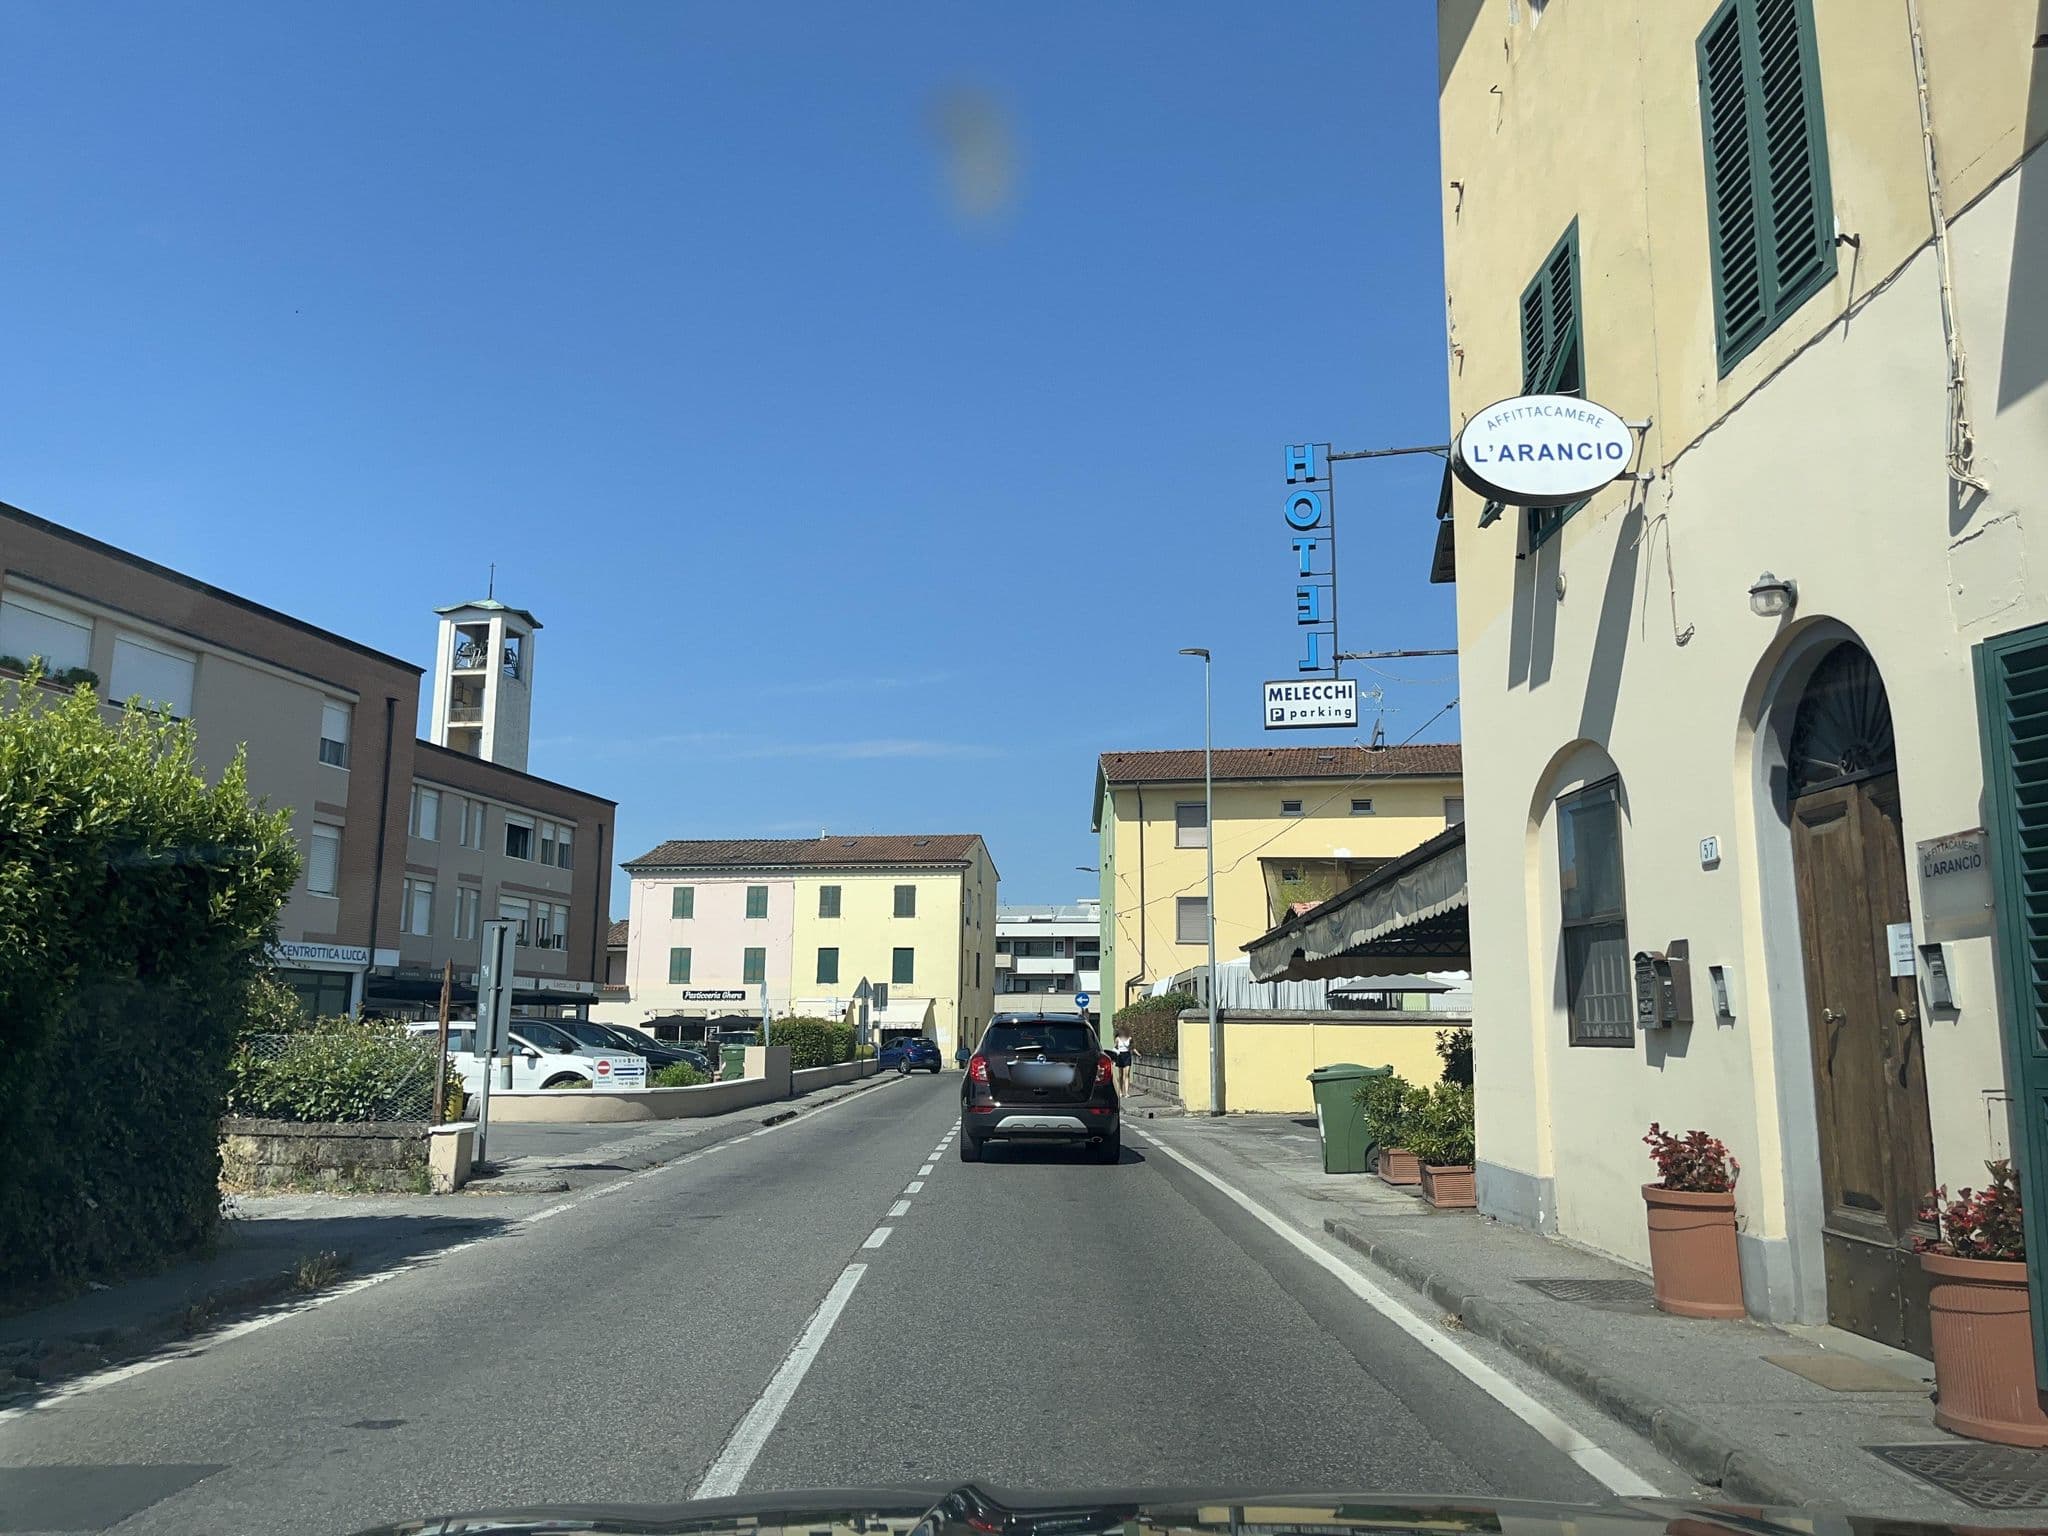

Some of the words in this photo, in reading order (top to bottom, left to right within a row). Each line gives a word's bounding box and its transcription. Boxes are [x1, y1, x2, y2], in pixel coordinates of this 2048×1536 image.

[1487, 405, 1605, 431] AFFITTACAMERE
[1268, 685, 1353, 702] MELECCHI
[1290, 706, 1352, 720] parking
[1703, 841, 1714, 859] 57
[1924, 839, 1979, 862] AFFITTACAMERE
[281, 945, 339, 960] CENTROTTICA
[341, 949, 367, 961] LUCCA
